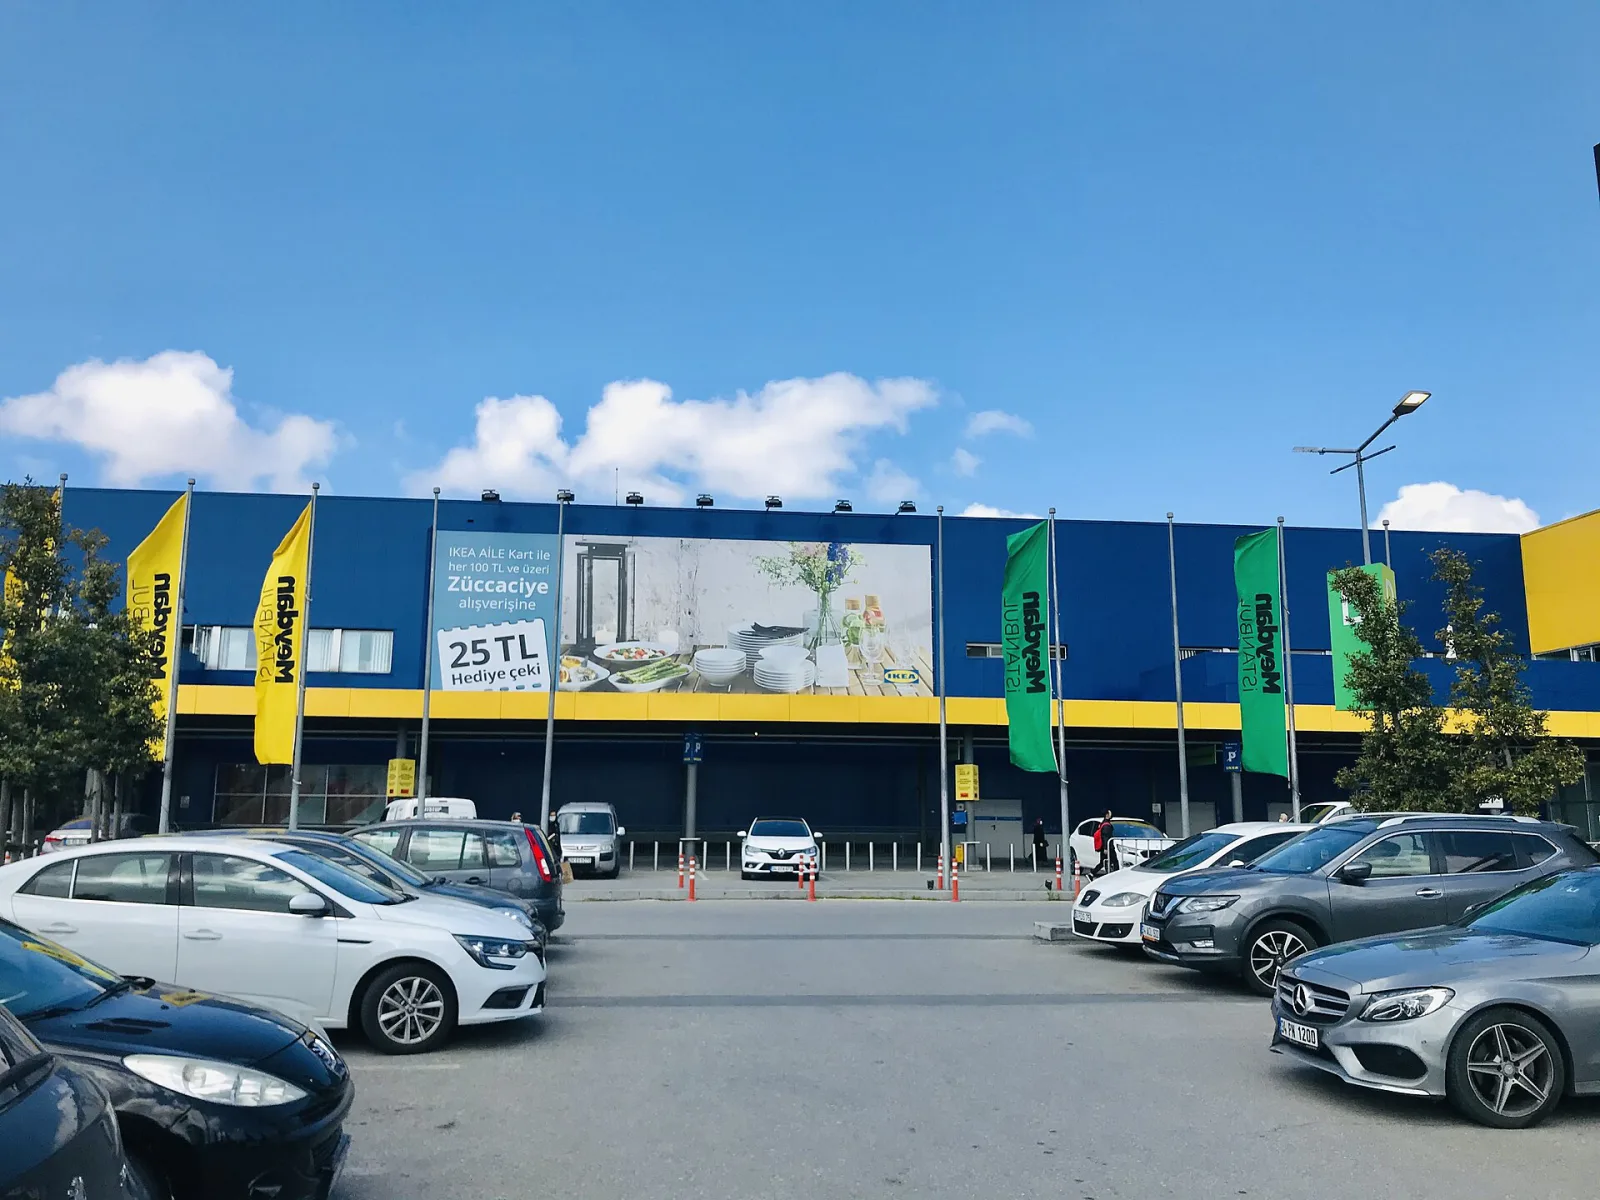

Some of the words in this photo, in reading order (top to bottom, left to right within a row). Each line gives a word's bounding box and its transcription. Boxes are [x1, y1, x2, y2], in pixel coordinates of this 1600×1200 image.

[449, 547, 476, 558] IKEA
[478, 545, 505, 559] AİLE
[508, 549, 534, 560] Kart
[536, 550, 551, 560] ile
[448, 561, 467, 572] her
[470, 563, 489, 573] 100
[492, 563, 505, 573] TL
[507, 566, 520, 574] ve
[522, 565, 550, 574] üzeri
[447, 575, 549, 598] Züccaciye
[459, 597, 536, 613] alışverişine
[449, 638, 491, 669] 25
[494, 633, 539, 662] TL
[451, 669, 506, 685] Hediye
[509, 662, 541, 681] çeki
[1297, 1026, 1317, 1045] 1200
